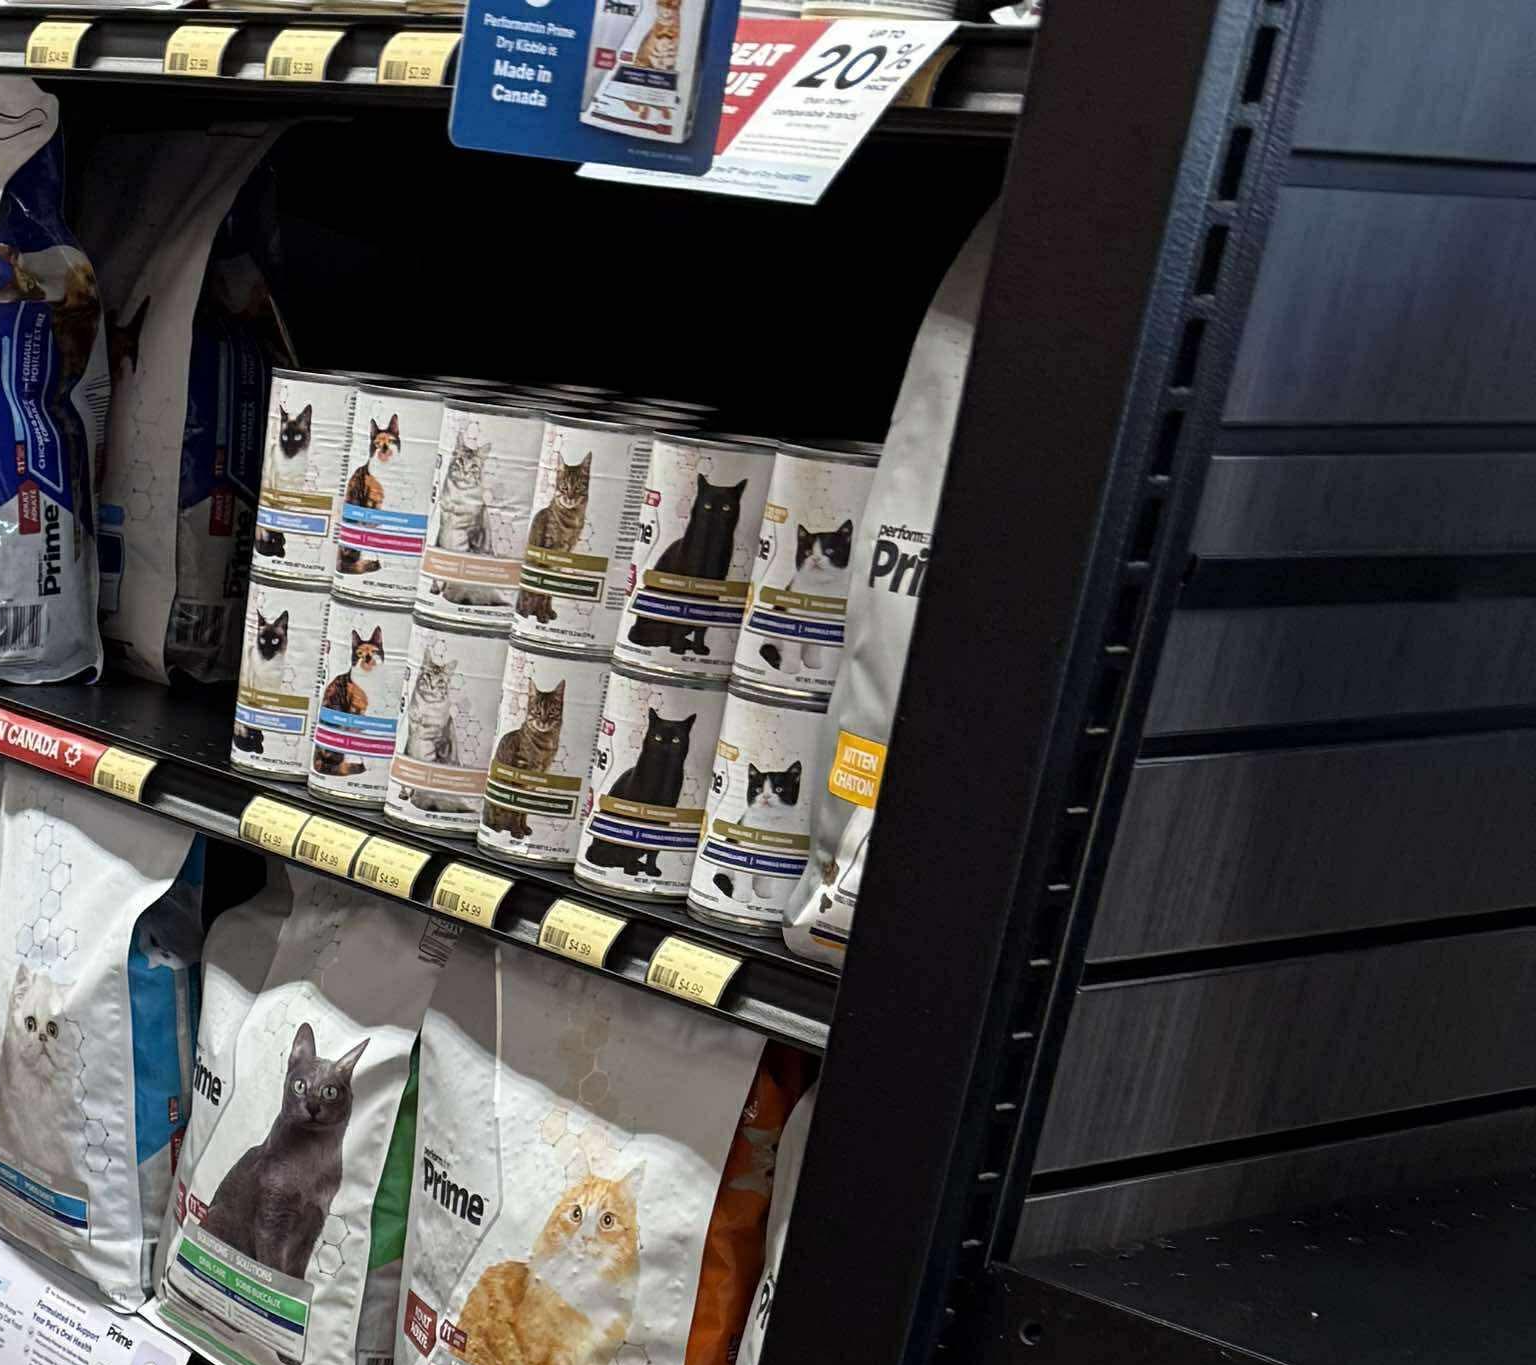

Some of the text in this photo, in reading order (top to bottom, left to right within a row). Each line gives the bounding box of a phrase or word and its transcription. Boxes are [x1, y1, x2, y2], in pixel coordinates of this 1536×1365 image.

[496, 36, 514, 51] Dry
[494, 60, 553, 83] Made in
[491, 85, 547, 107] Canada
[42, 503, 62, 596] Prime
[870, 540, 929, 599] Pri
[7, 725, 59, 760] CANADA
[842, 746, 879, 771] KITTEN
[832, 768, 876, 799] CHATON
[379, 872, 400, 889] $4.99
[460, 901, 481, 917] $4.99
[423, 1156, 485, 1226] Prime
[235, 1254, 273, 1283] SOLUTIONS
[75, 1323, 100, 1342] Support
[106, 1326, 133, 1350] Prime
